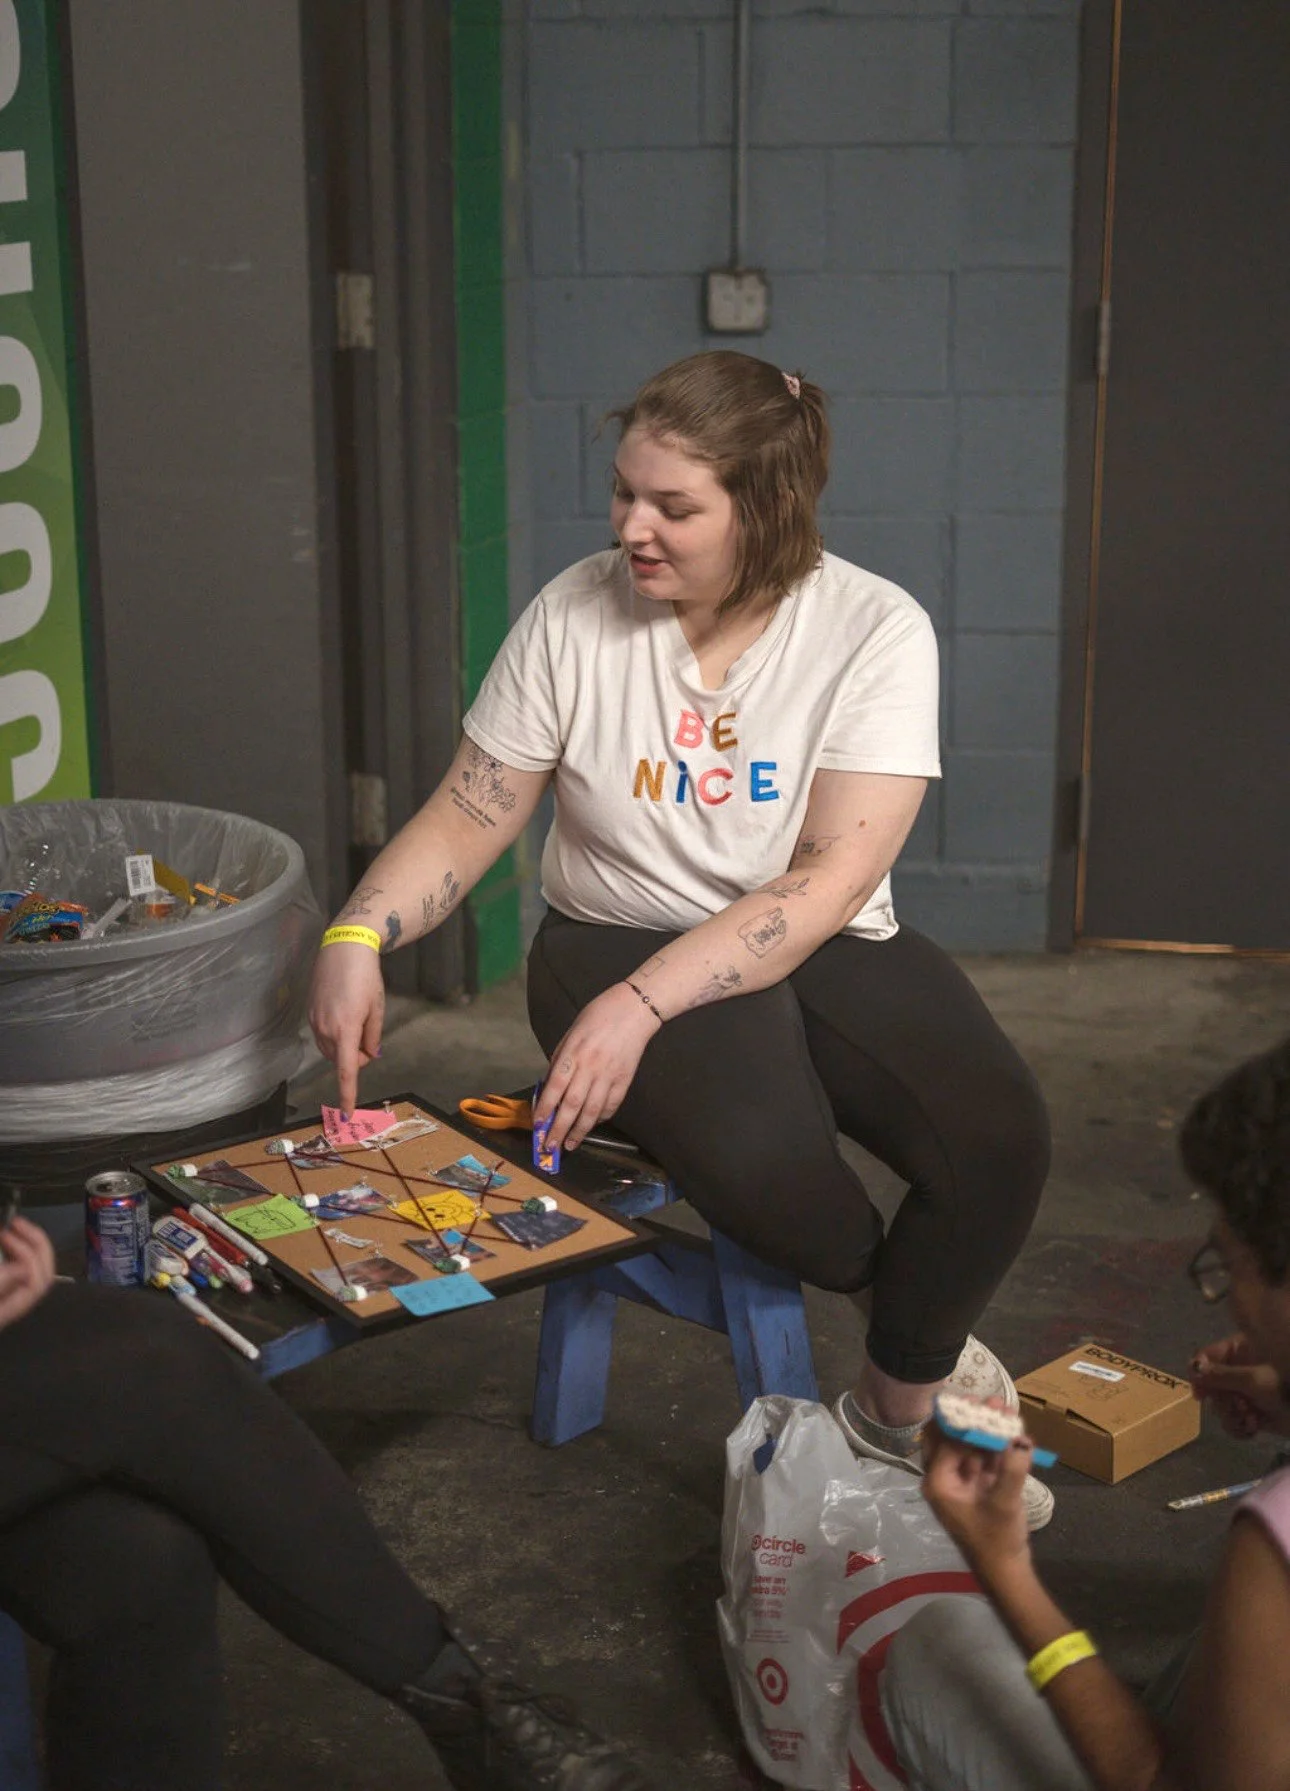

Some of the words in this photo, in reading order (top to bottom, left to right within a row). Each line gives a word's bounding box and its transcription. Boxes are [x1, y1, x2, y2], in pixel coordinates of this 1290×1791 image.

[674, 709, 739, 752] BE
[1084, 1346, 1183, 1389] BODYPROX
[760, 1552, 793, 1568] card
[762, 1535, 806, 1555] circle
